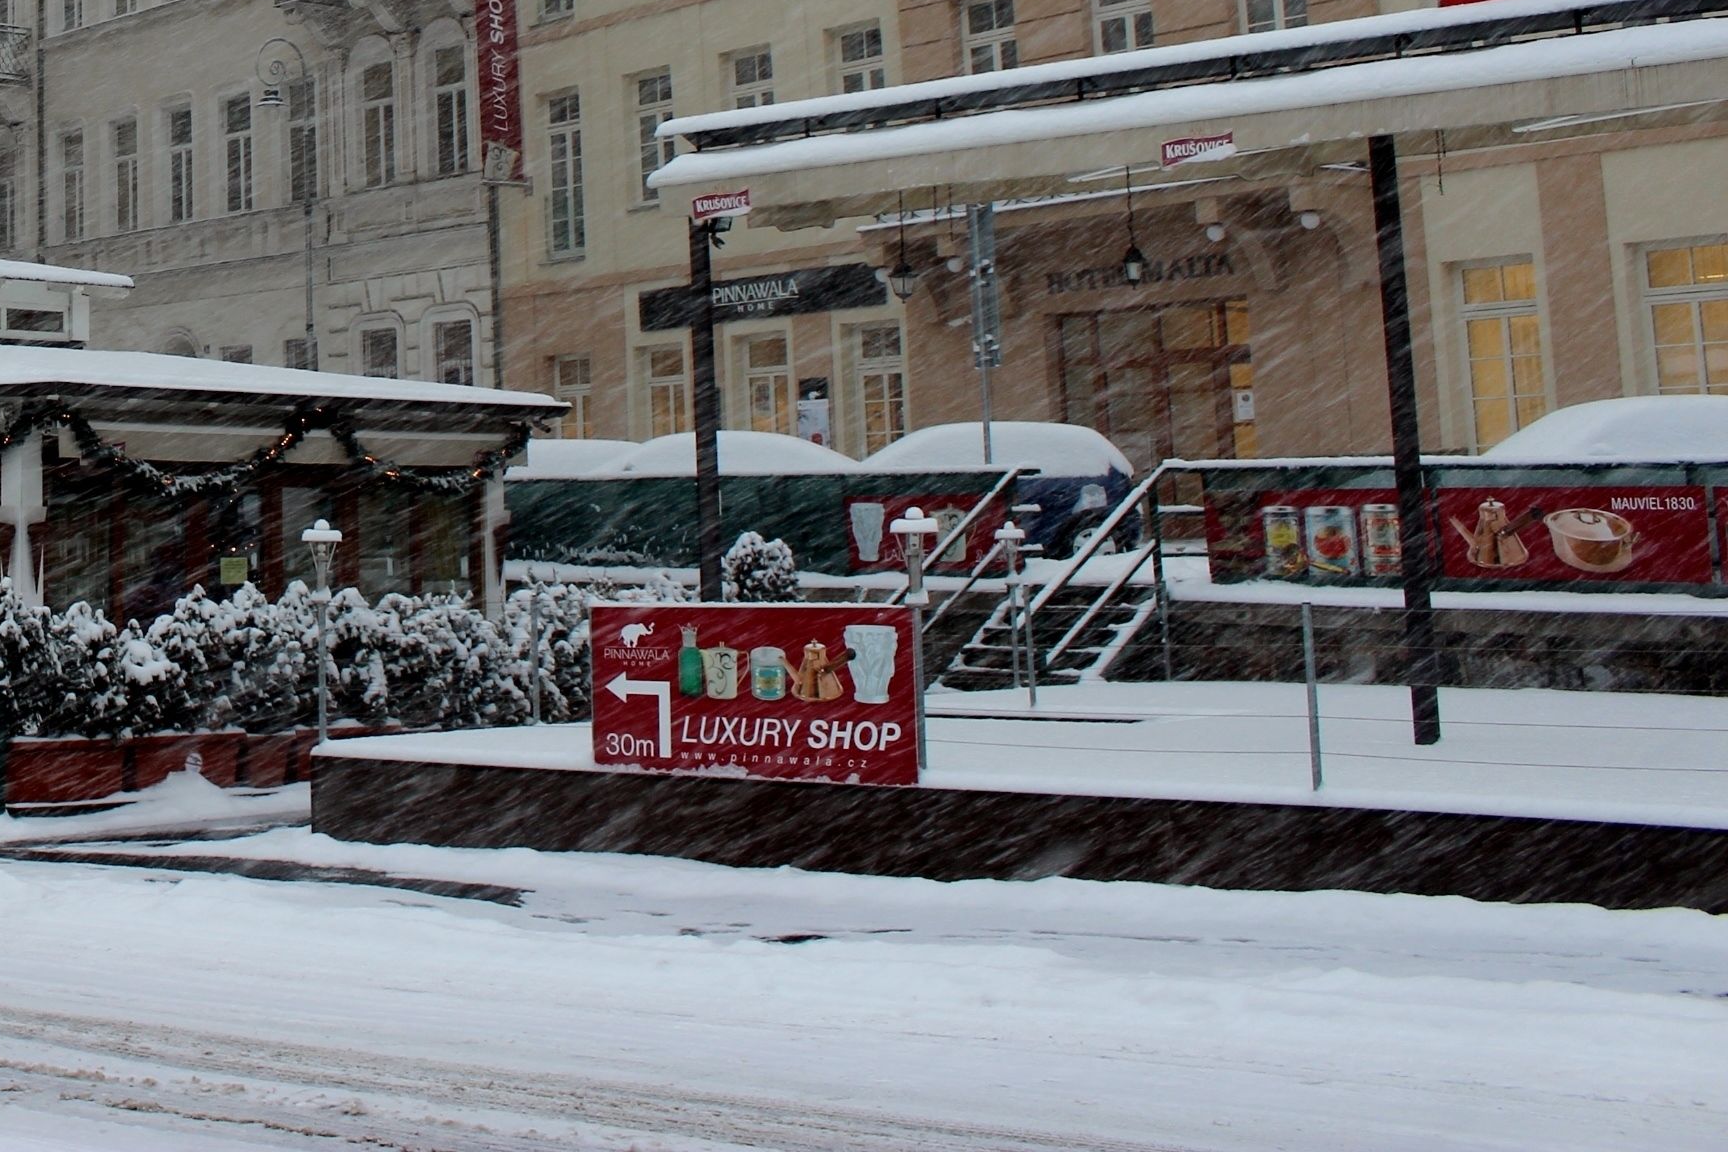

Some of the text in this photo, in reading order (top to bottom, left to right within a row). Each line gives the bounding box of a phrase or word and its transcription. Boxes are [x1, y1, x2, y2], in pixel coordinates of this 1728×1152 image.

[491, 48, 509, 132] LUXURY
[712, 278, 799, 304] PINNAWALA
[737, 301, 775, 313] HOME
[603, 647, 670, 660] PINNAWALA
[623, 660, 651, 668] HOME
[681, 715, 902, 752] LUXURY SHOP
[605, 733, 655, 757] 30m
[681, 751, 867, 768] www.pinnawala.cz
